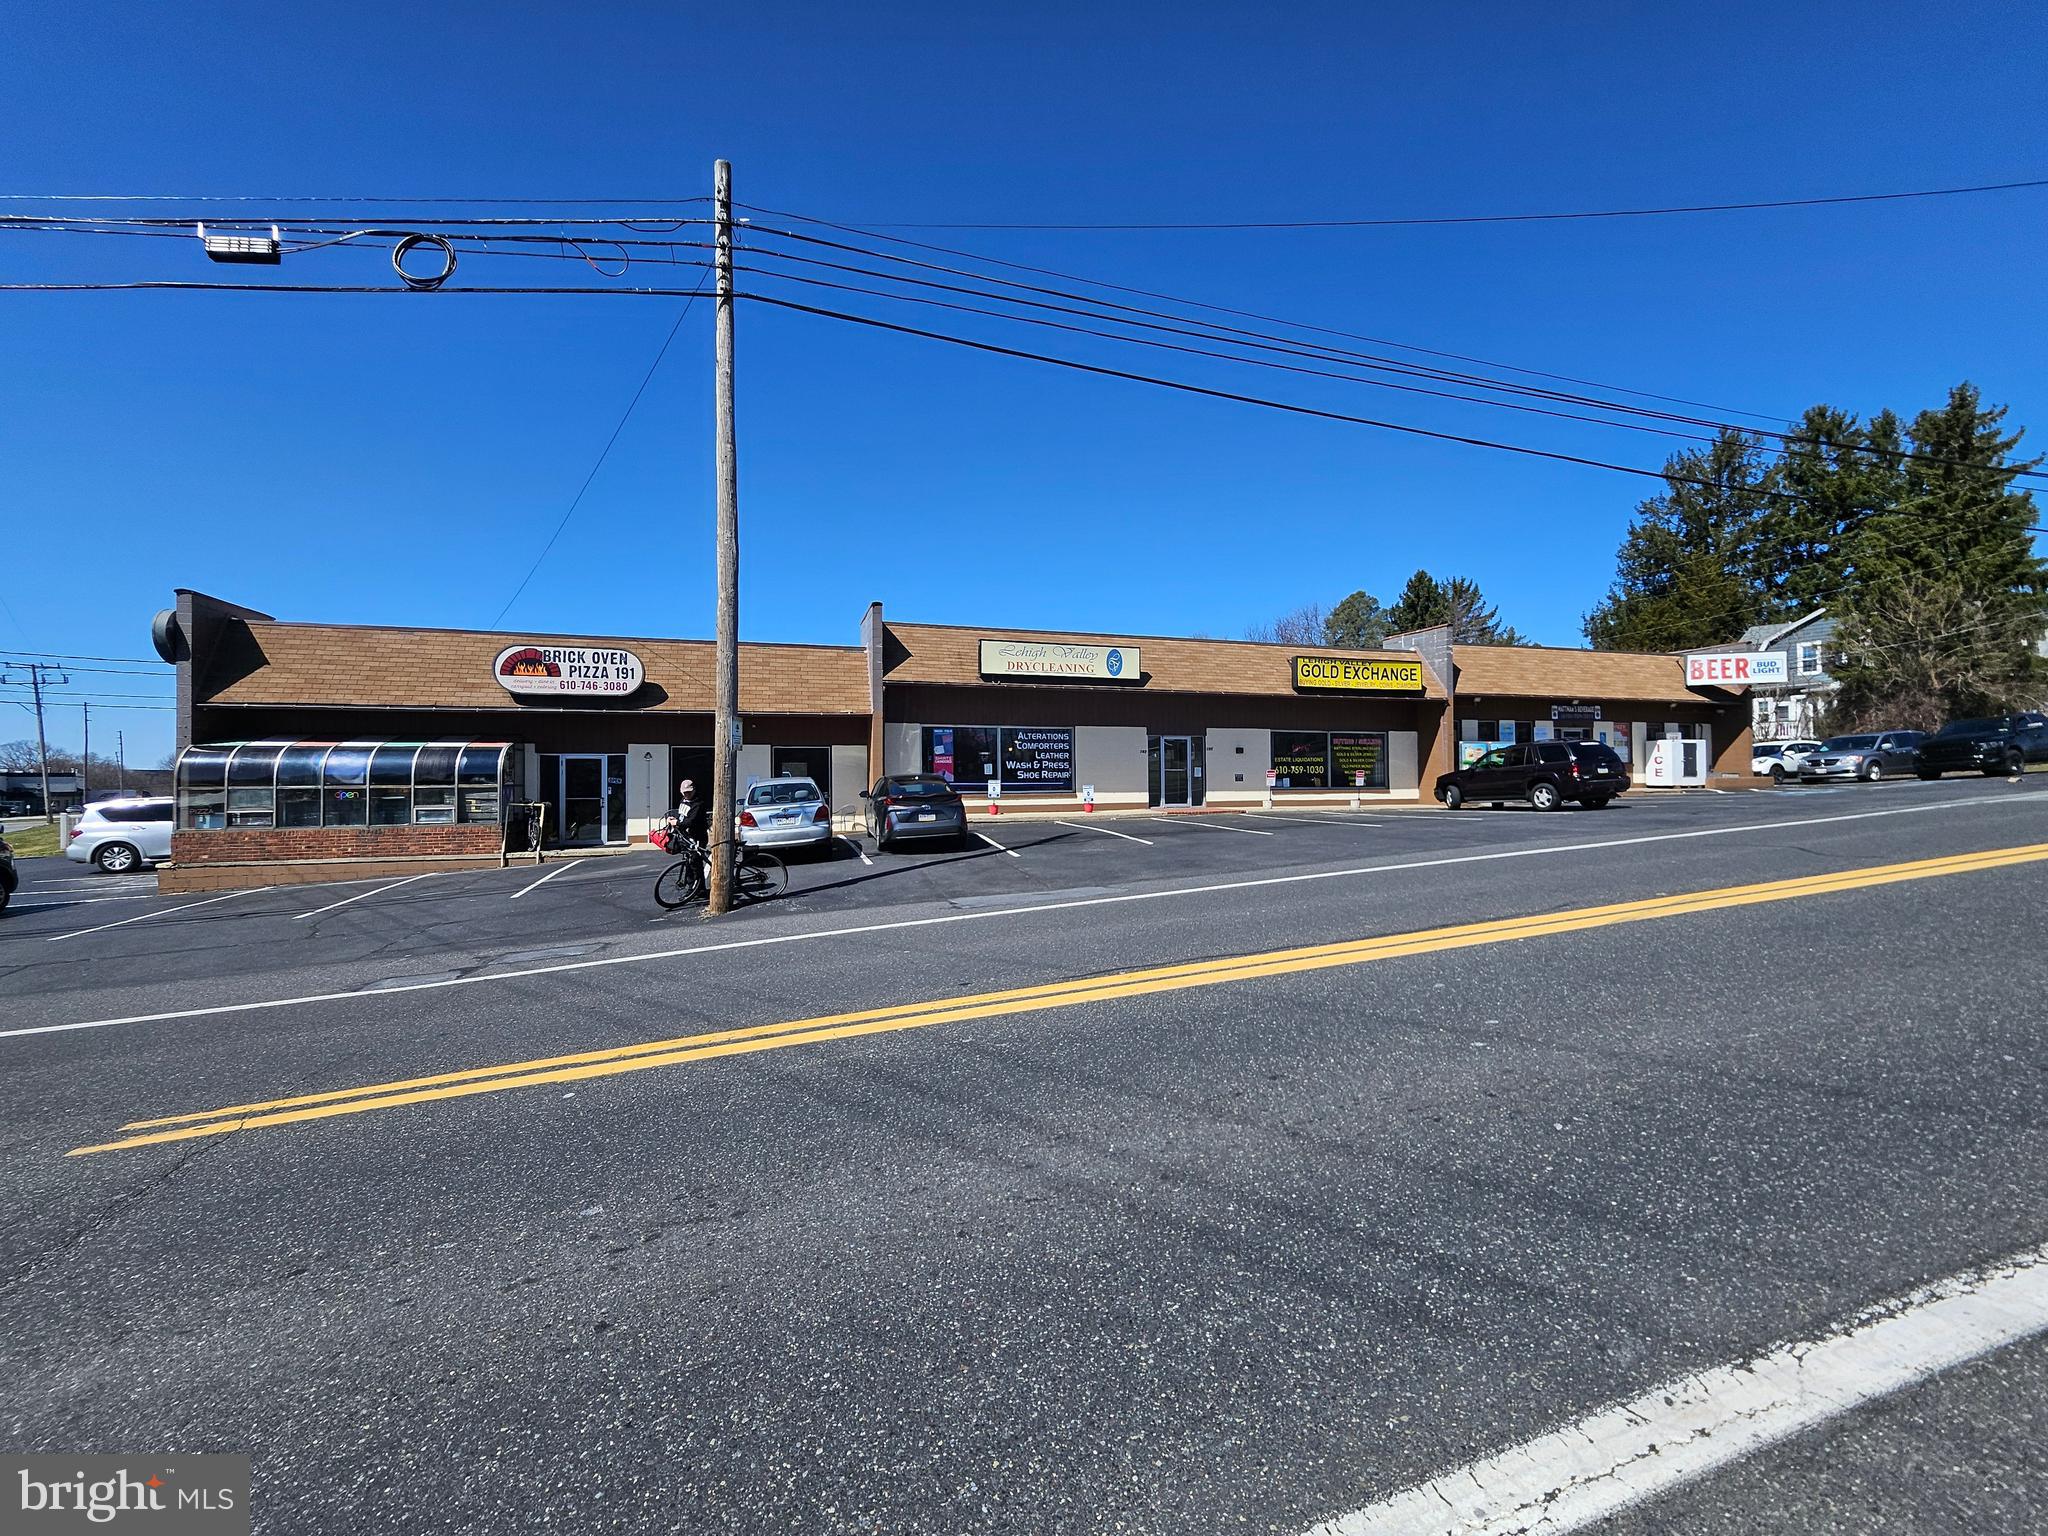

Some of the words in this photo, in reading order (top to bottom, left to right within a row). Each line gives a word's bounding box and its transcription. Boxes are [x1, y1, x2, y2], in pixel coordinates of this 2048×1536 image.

[542, 650, 586, 664] BRICK
[592, 651, 628, 665] OVEN
[999, 644, 1047, 661] Lehigh
[1052, 646, 1099, 663] Valley
[569, 665, 609, 679] PIZZA
[614, 667, 635, 679] 191
[1007, 661, 1095, 673] DRYCLEANING
[1301, 664, 1339, 679] GOLD
[1343, 666, 1418, 681] EXCHANGE
[1690, 658, 1750, 680] BEER
[559, 680, 628, 691] 610-746-3080
[1017, 731, 1069, 740] ALTERATIONS
[1016, 742, 1069, 750] COMFORTERS
[1035, 751, 1069, 759] LEATHER
[1654, 743, 1664, 778] ICE
[1006, 760, 1032, 769] WASH
[1033, 760, 1040, 769] &
[1042, 760, 1070, 769] PRESS
[1017, 770, 1040, 779] SHOE
[1041, 770, 1070, 779] REPAIR
